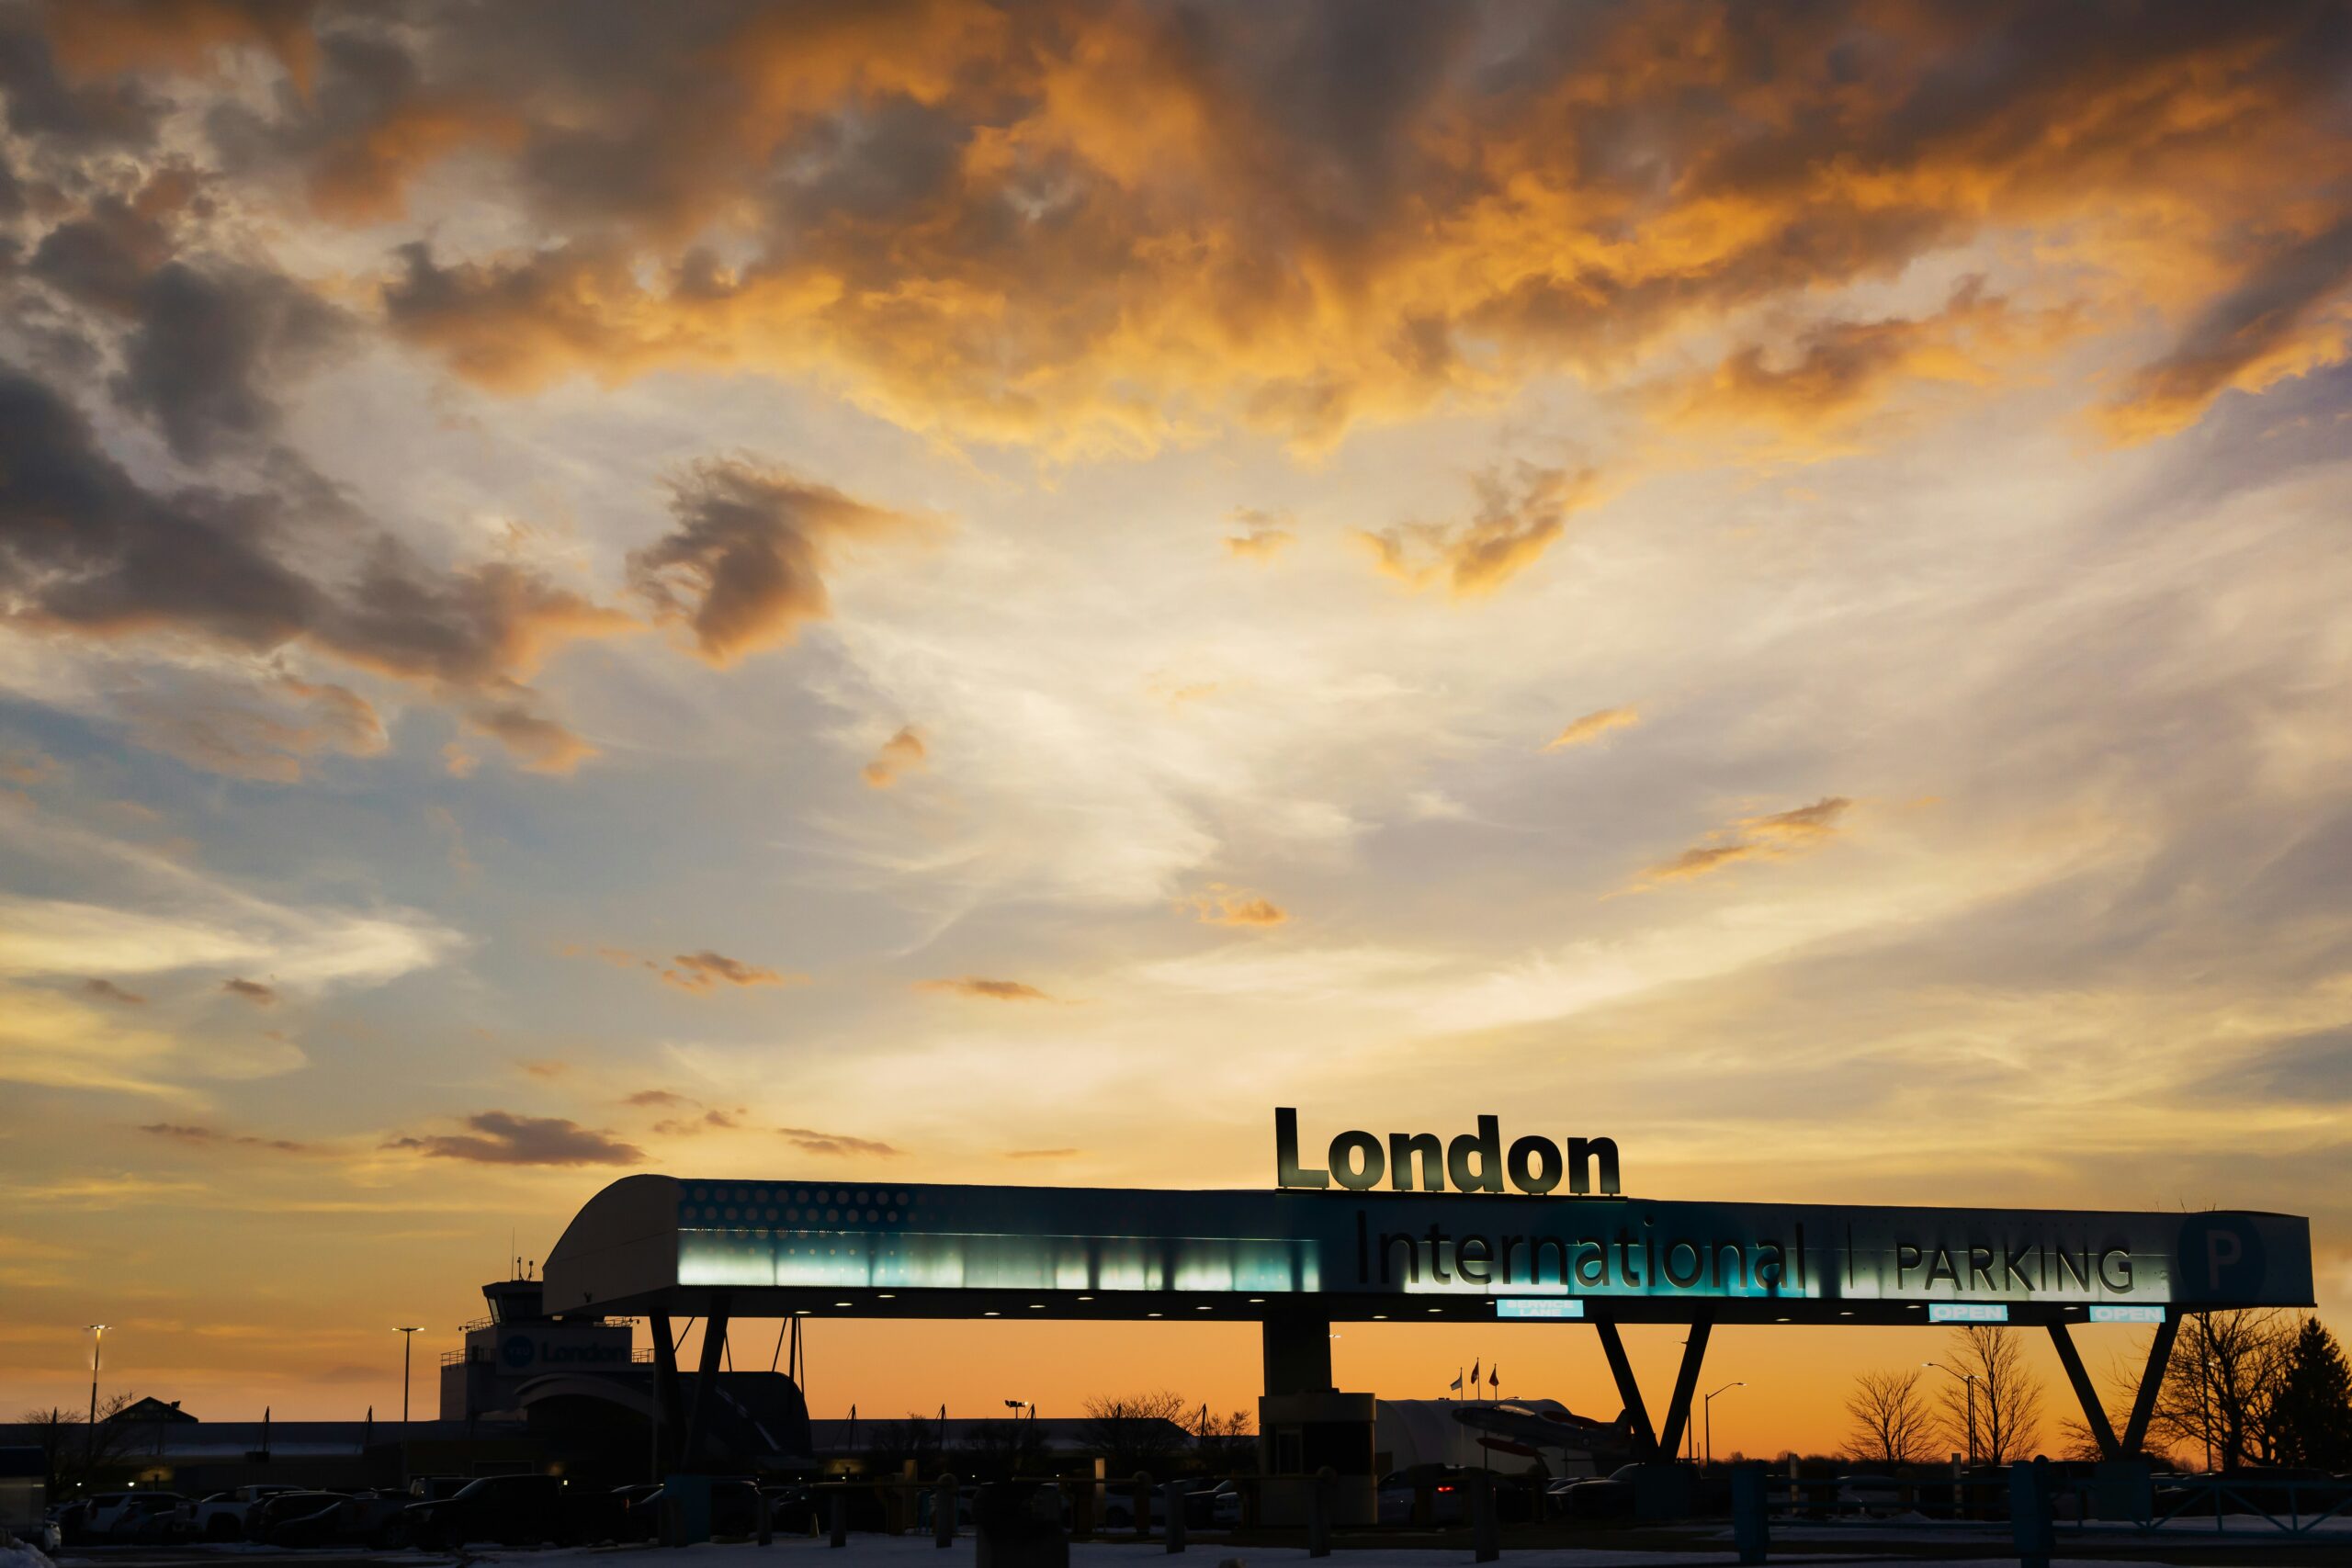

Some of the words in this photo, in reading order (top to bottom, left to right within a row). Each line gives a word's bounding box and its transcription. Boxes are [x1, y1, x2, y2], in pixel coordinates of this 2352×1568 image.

[1275, 1107, 1621, 1194] London
[1357, 1210, 1804, 1289] International
[1895, 1240, 2134, 1293] PARKING
[2207, 1229, 2242, 1291] P
[1506, 1300, 1574, 1308] SERVICE
[1520, 1308, 1561, 1316] LANE
[1933, 1305, 2002, 1320] OPEN
[2095, 1307, 2162, 1321] OPEN
[542, 1341, 626, 1361] London
